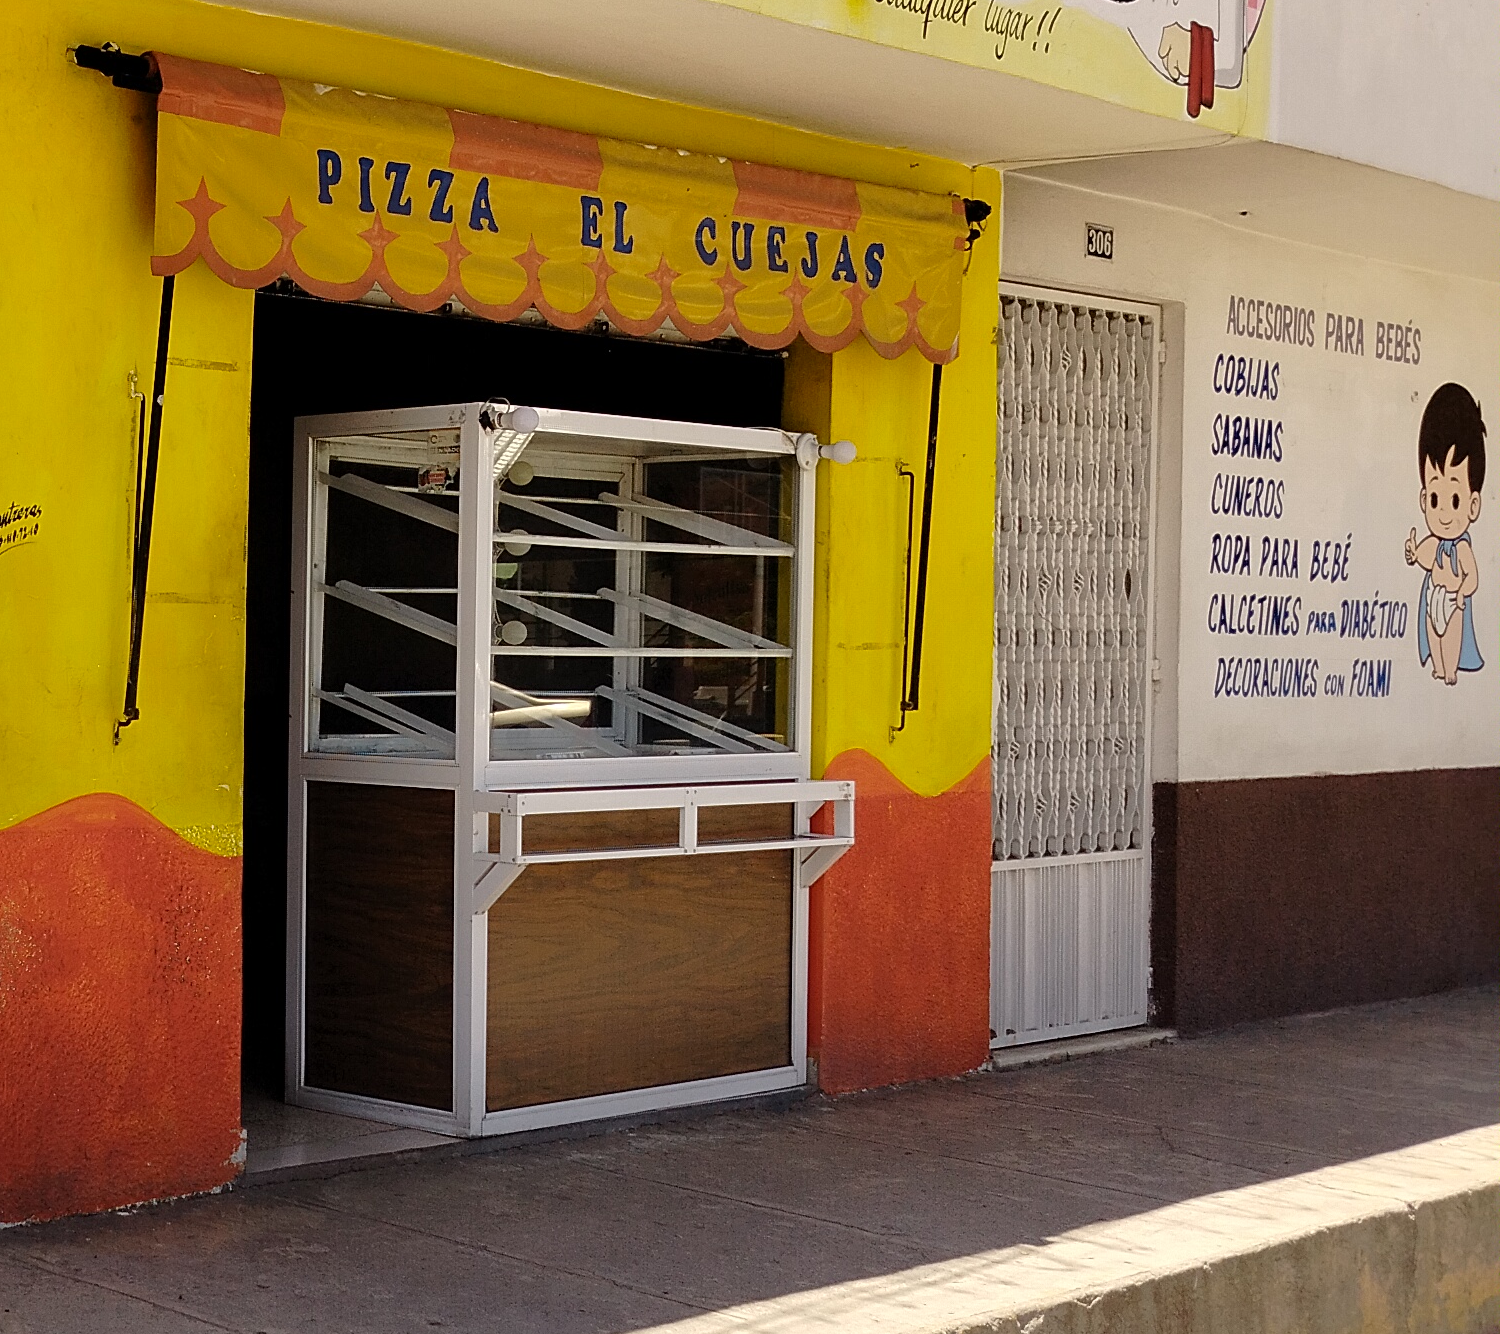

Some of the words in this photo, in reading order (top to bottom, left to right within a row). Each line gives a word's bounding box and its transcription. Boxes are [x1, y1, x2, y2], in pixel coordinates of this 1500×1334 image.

[316, 149, 499, 233] PIZZA
[581, 195, 634, 254] EL
[694, 216, 886, 289] CUEJAS
[1088, 230, 1112, 256] 306
[1226, 295, 1315, 347] ACCESORIOS
[1324, 312, 1365, 356] PARA
[1376, 319, 1421, 365] BEBÉS
[1213, 353, 1280, 401] COBIJAS
[1211, 413, 1284, 462] SABANAS
[1211, 473, 1284, 519] CUNEROS
[1210, 533, 1250, 576] ROPA
[1259, 536, 1299, 579] PARA
[1309, 533, 1352, 583] BEBÉ
[1208, 594, 1302, 636] CALCETINES
[1305, 610, 1336, 635] PARA
[1340, 590, 1409, 640] DIABÉTICO
[1214, 657, 1319, 698] DECORACIONES
[1324, 674, 1346, 697] CON
[1349, 658, 1392, 697] FOAMI
